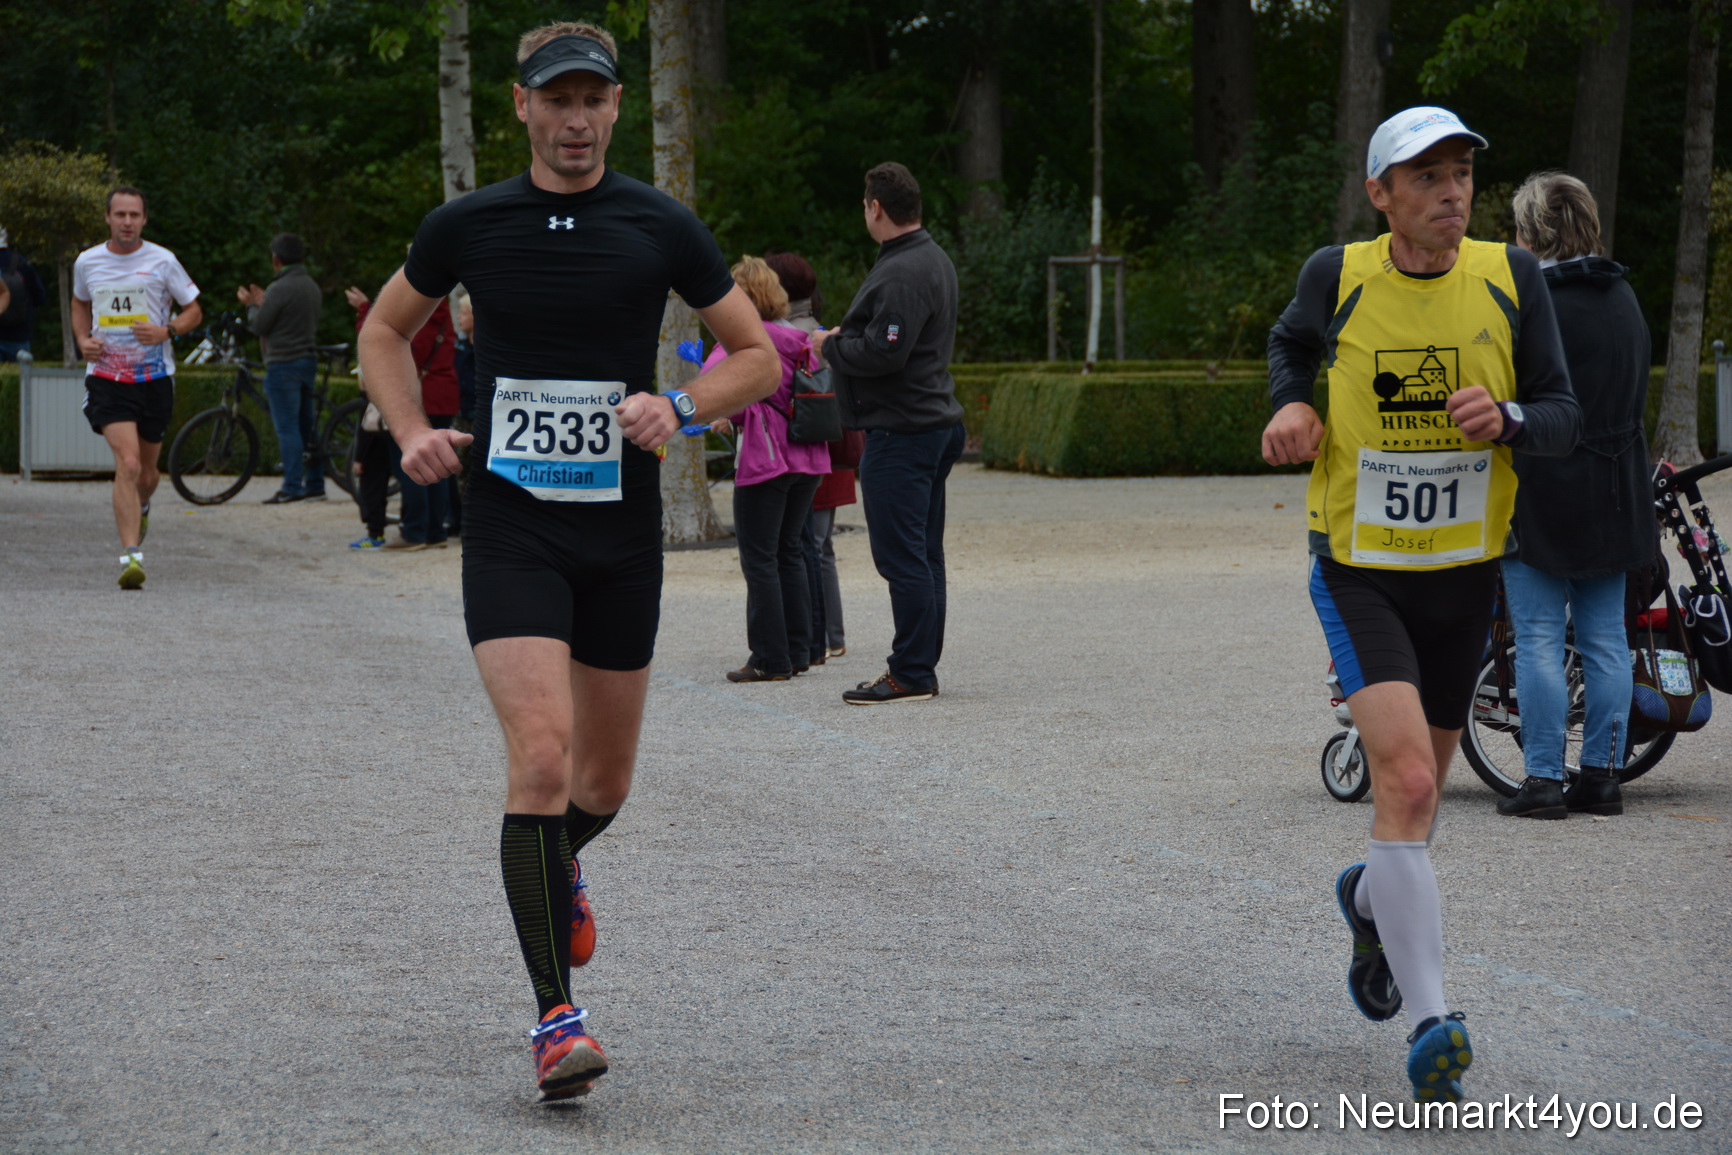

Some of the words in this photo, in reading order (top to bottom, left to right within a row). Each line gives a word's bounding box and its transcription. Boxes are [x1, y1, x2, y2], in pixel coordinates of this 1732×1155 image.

[111, 296, 132, 312] 44
[496, 389, 538, 403] PARTL
[541, 392, 603, 405] Neumarkt
[1381, 414, 1459, 430] HIRSCH
[505, 408, 611, 455] 2533
[1382, 438, 1462, 447] APOTHEKE
[517, 464, 594, 485] Christian
[1361, 459, 1404, 475] PARTL
[1408, 463, 1469, 476] Neumarkt
[1385, 479, 1459, 523] 501
[1381, 528, 1440, 551] Josef
